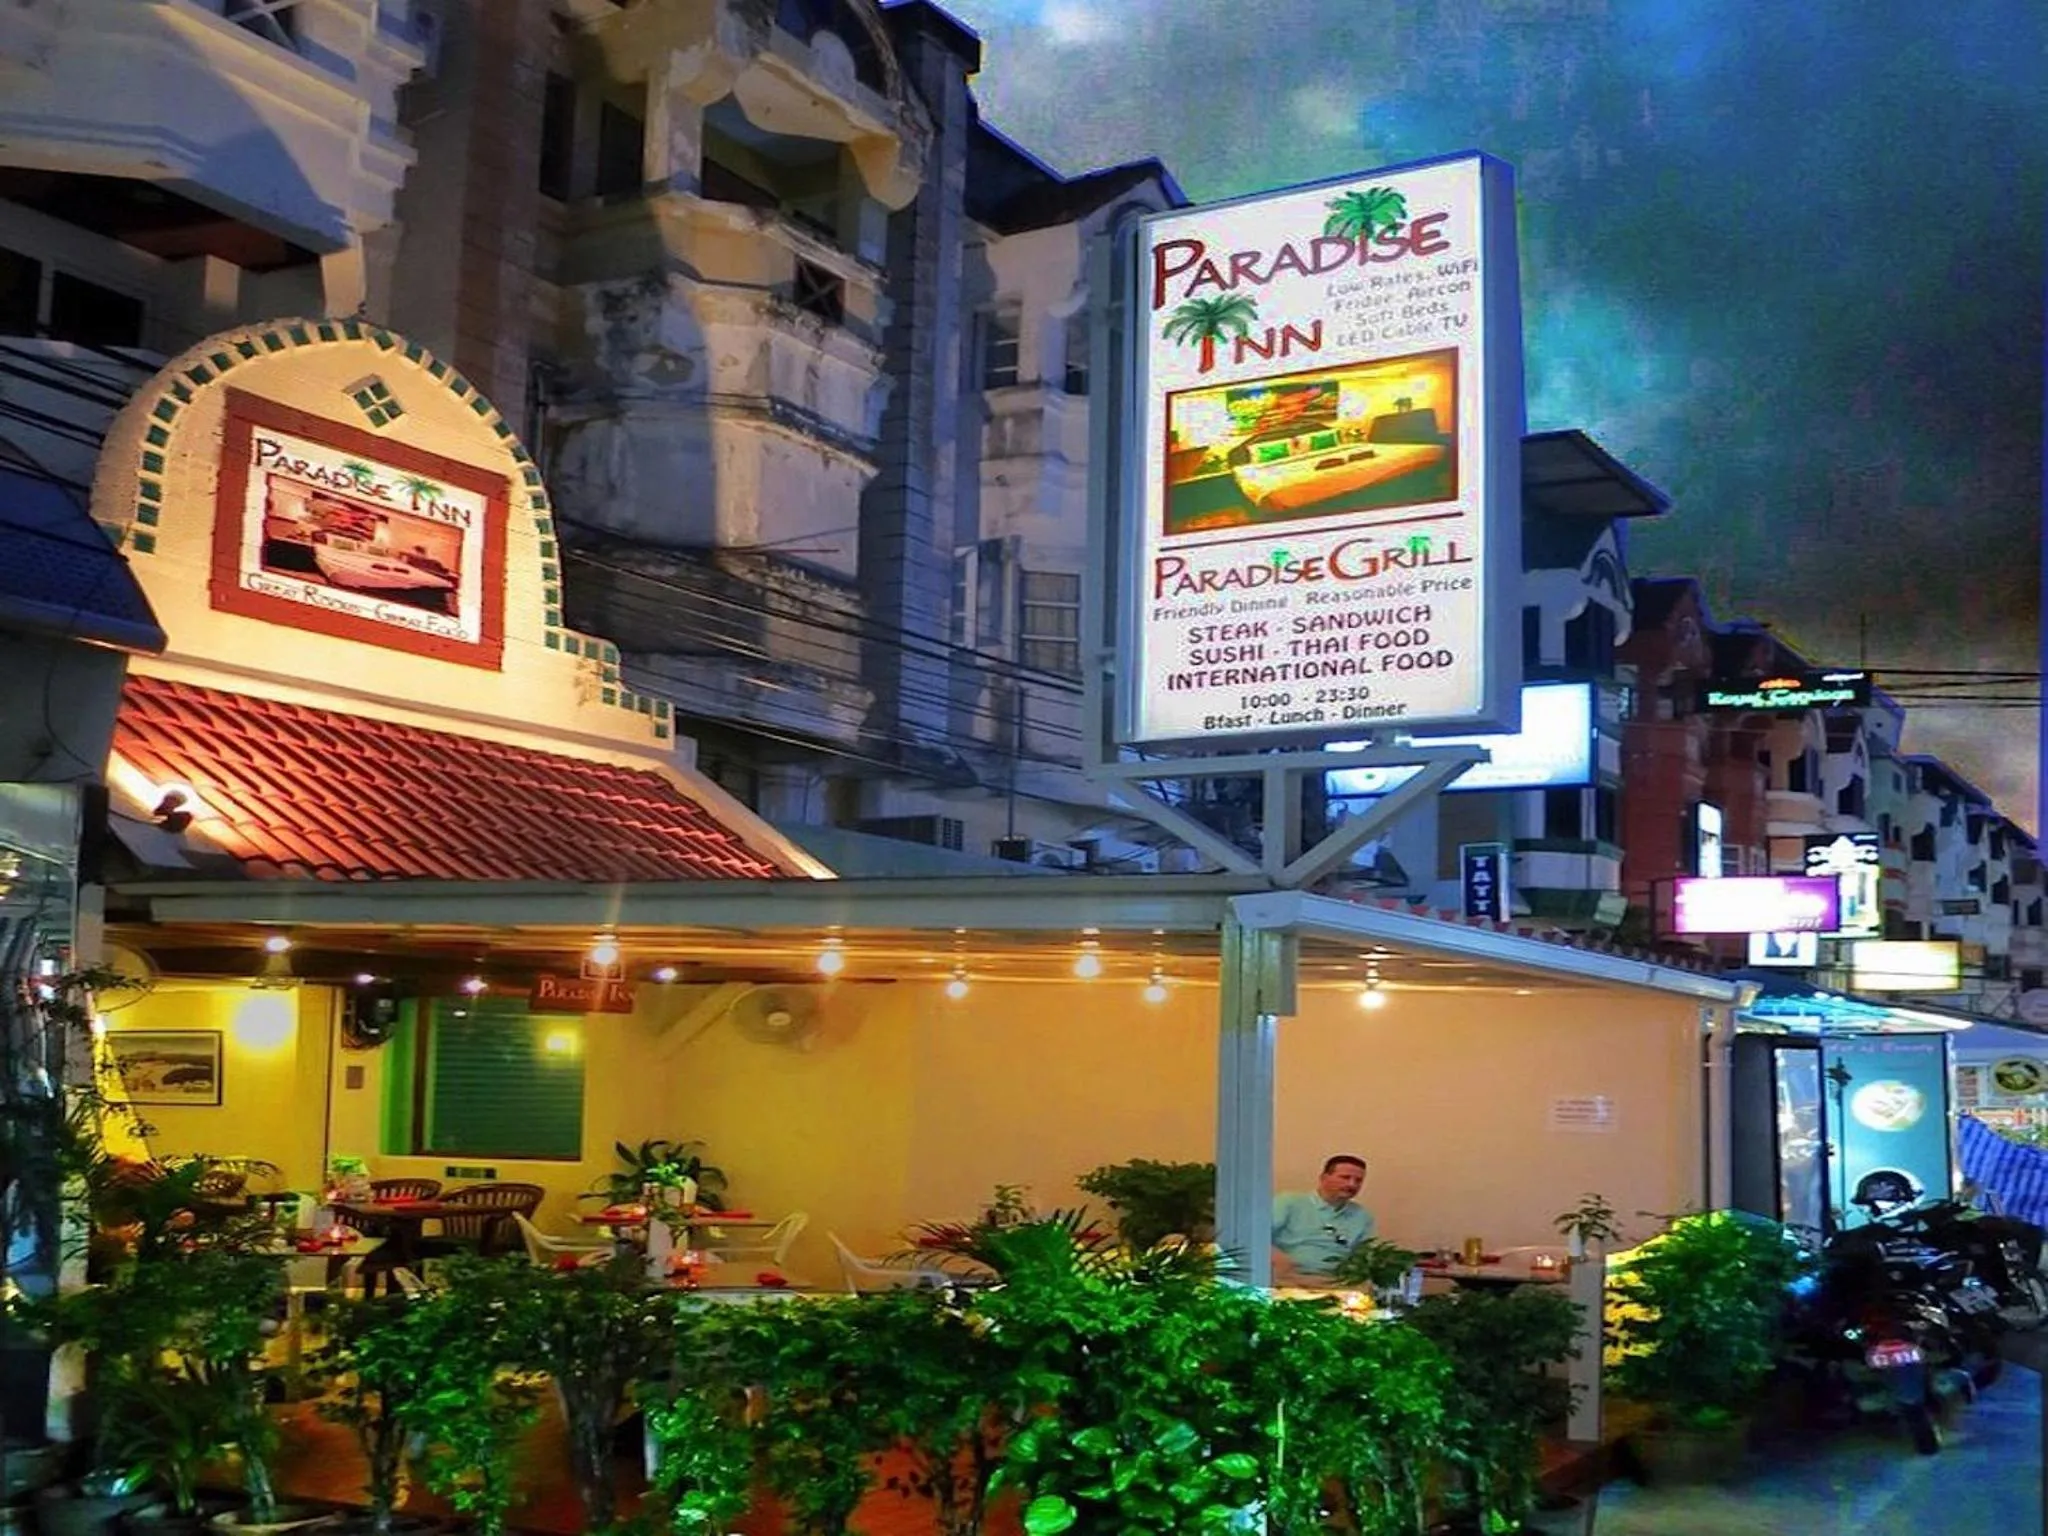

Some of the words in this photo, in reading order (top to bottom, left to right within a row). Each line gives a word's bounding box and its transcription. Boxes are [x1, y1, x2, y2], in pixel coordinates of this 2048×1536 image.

[1151, 212, 1450, 310] PARADISE
[1327, 282, 1364, 297] Low
[1401, 301, 1449, 319] Beds
[1198, 319, 1323, 374] INN
[1336, 328, 1375, 346] LED
[1440, 312, 1469, 331] TV
[254, 437, 393, 502] PARADISE
[411, 490, 472, 528] INN
[1154, 555, 1325, 600] PARADISE
[1327, 538, 1473, 582] GRILL
[1153, 602, 1224, 622] Friendly
[1231, 597, 1289, 615] Dining
[1306, 580, 1415, 605] Reasonable
[1421, 576, 1473, 594] Price
[1188, 620, 1269, 645] STEAK
[1292, 604, 1432, 635] SANDWICH
[1189, 643, 1265, 667] SUSHI
[1288, 635, 1350, 658] THAI
[1359, 627, 1430, 651] FOOD
[1167, 656, 1374, 691] INTERNATIONAL
[1381, 648, 1455, 673] FOOD
[1204, 713, 1252, 731] Bfast
[1268, 708, 1325, 726] Lunch
[1342, 702, 1408, 722] Dinner
[1240, 691, 1292, 710] 10:00
[1315, 686, 1370, 705] 23:30
[1471, 855, 1493, 918] TATT
